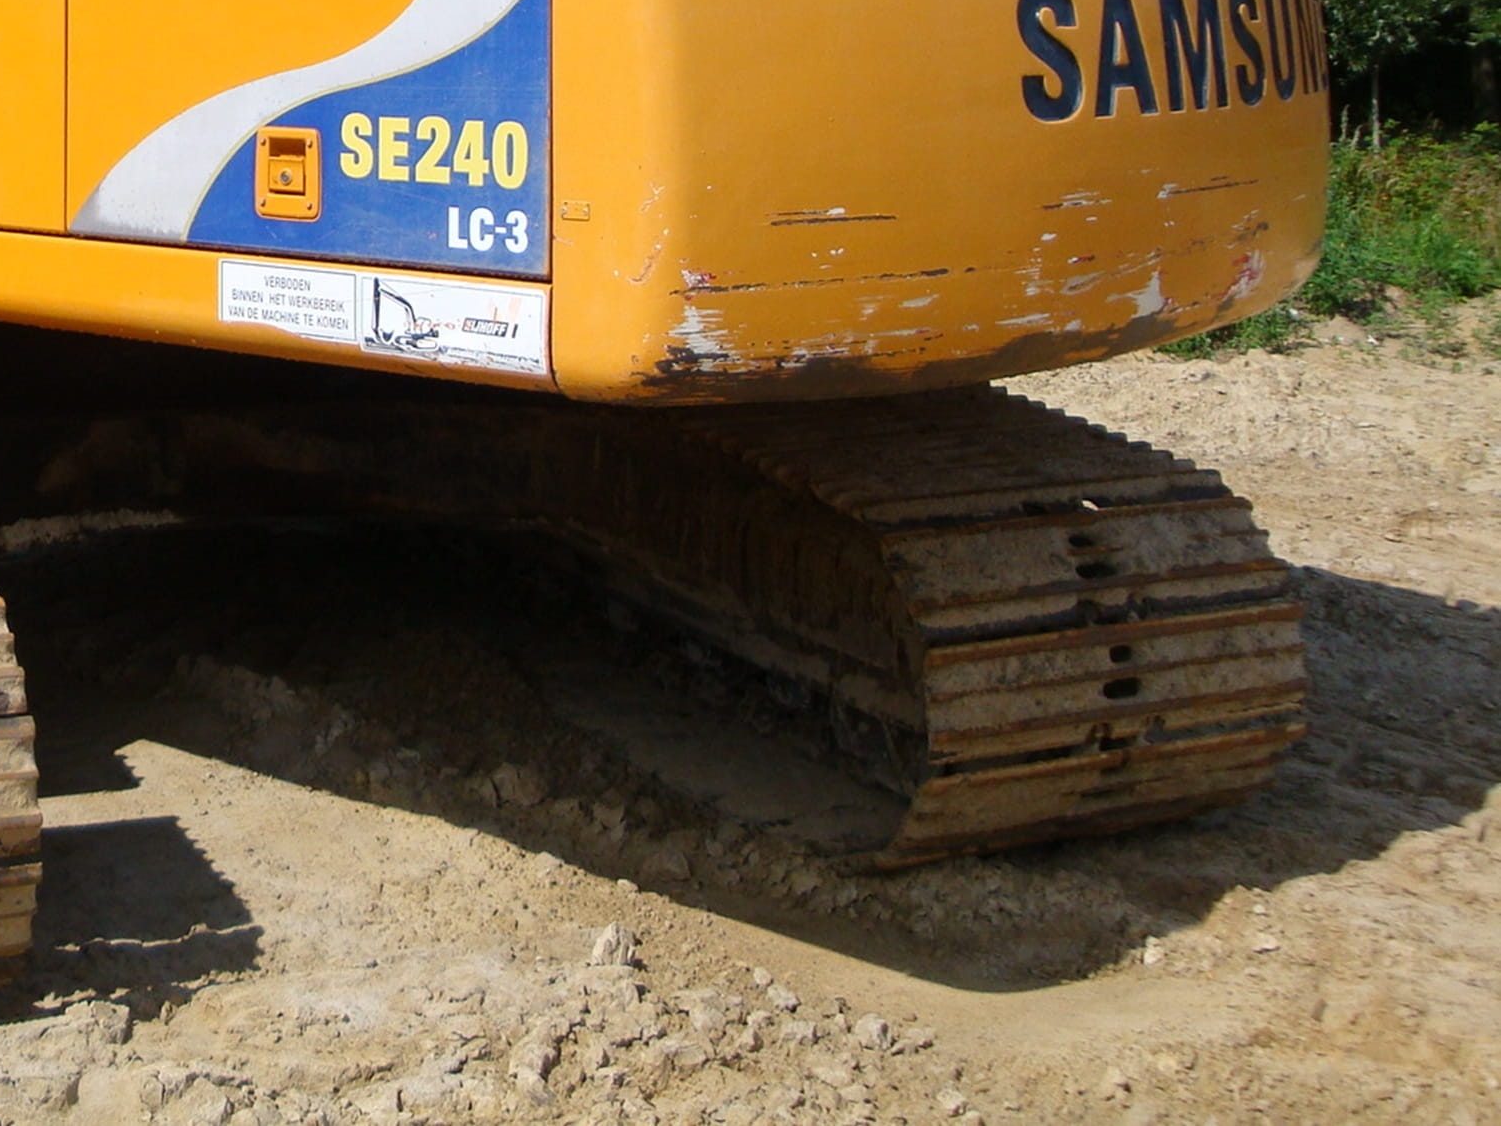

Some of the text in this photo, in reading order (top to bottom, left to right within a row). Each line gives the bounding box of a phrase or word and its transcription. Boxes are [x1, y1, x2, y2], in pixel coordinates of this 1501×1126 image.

[339, 112, 529, 190] SE240
[447, 206, 529, 254] LC-3
[263, 275, 311, 291] VERBODEN
[231, 288, 345, 312] BINNEN HET WERKBEREIK
[228, 305, 349, 330] VAN DE MACHINE TE KOMEN
